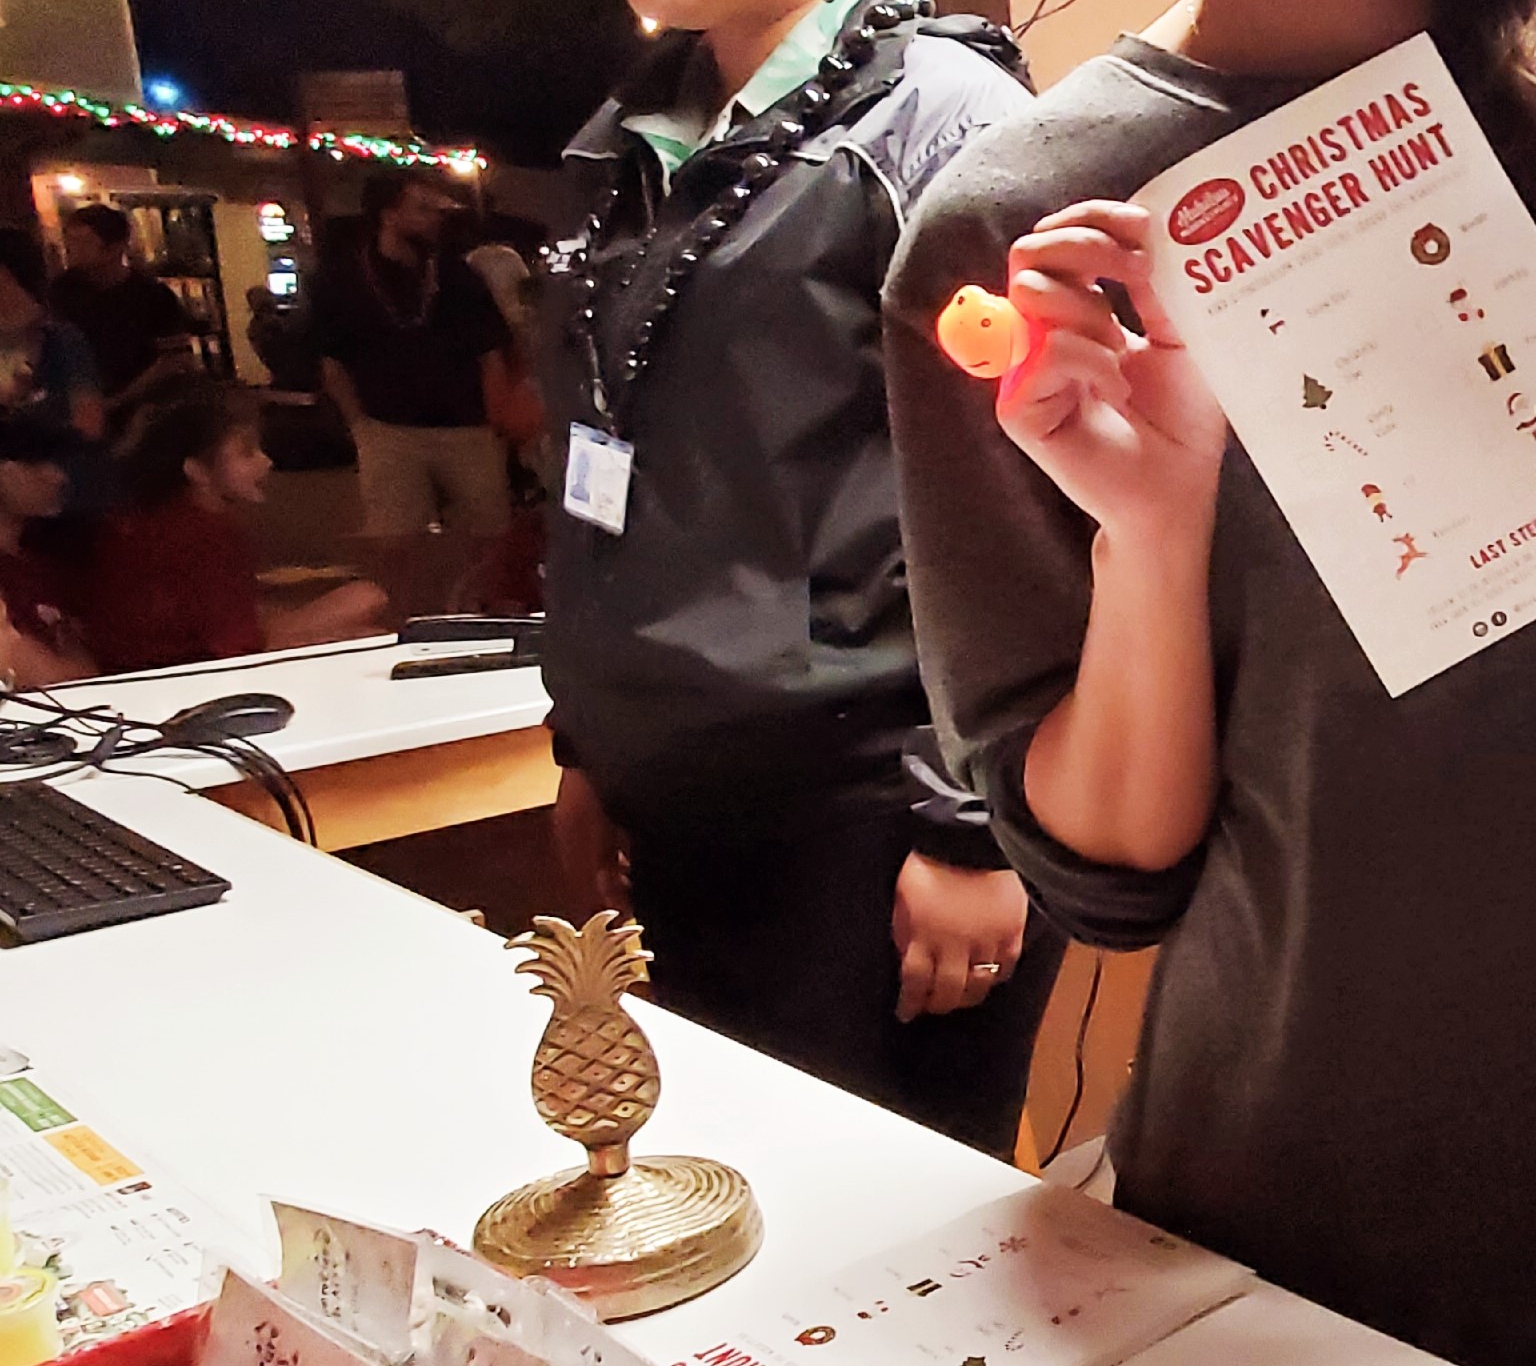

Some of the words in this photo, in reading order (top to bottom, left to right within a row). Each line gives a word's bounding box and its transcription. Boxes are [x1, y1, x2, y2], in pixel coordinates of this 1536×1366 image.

[1249, 83, 1431, 200] CHRISTMAS
[1184, 172, 1370, 294] SCAVENGER
[1368, 122, 1453, 192] HUNT
[1470, 539, 1507, 569] LAST
